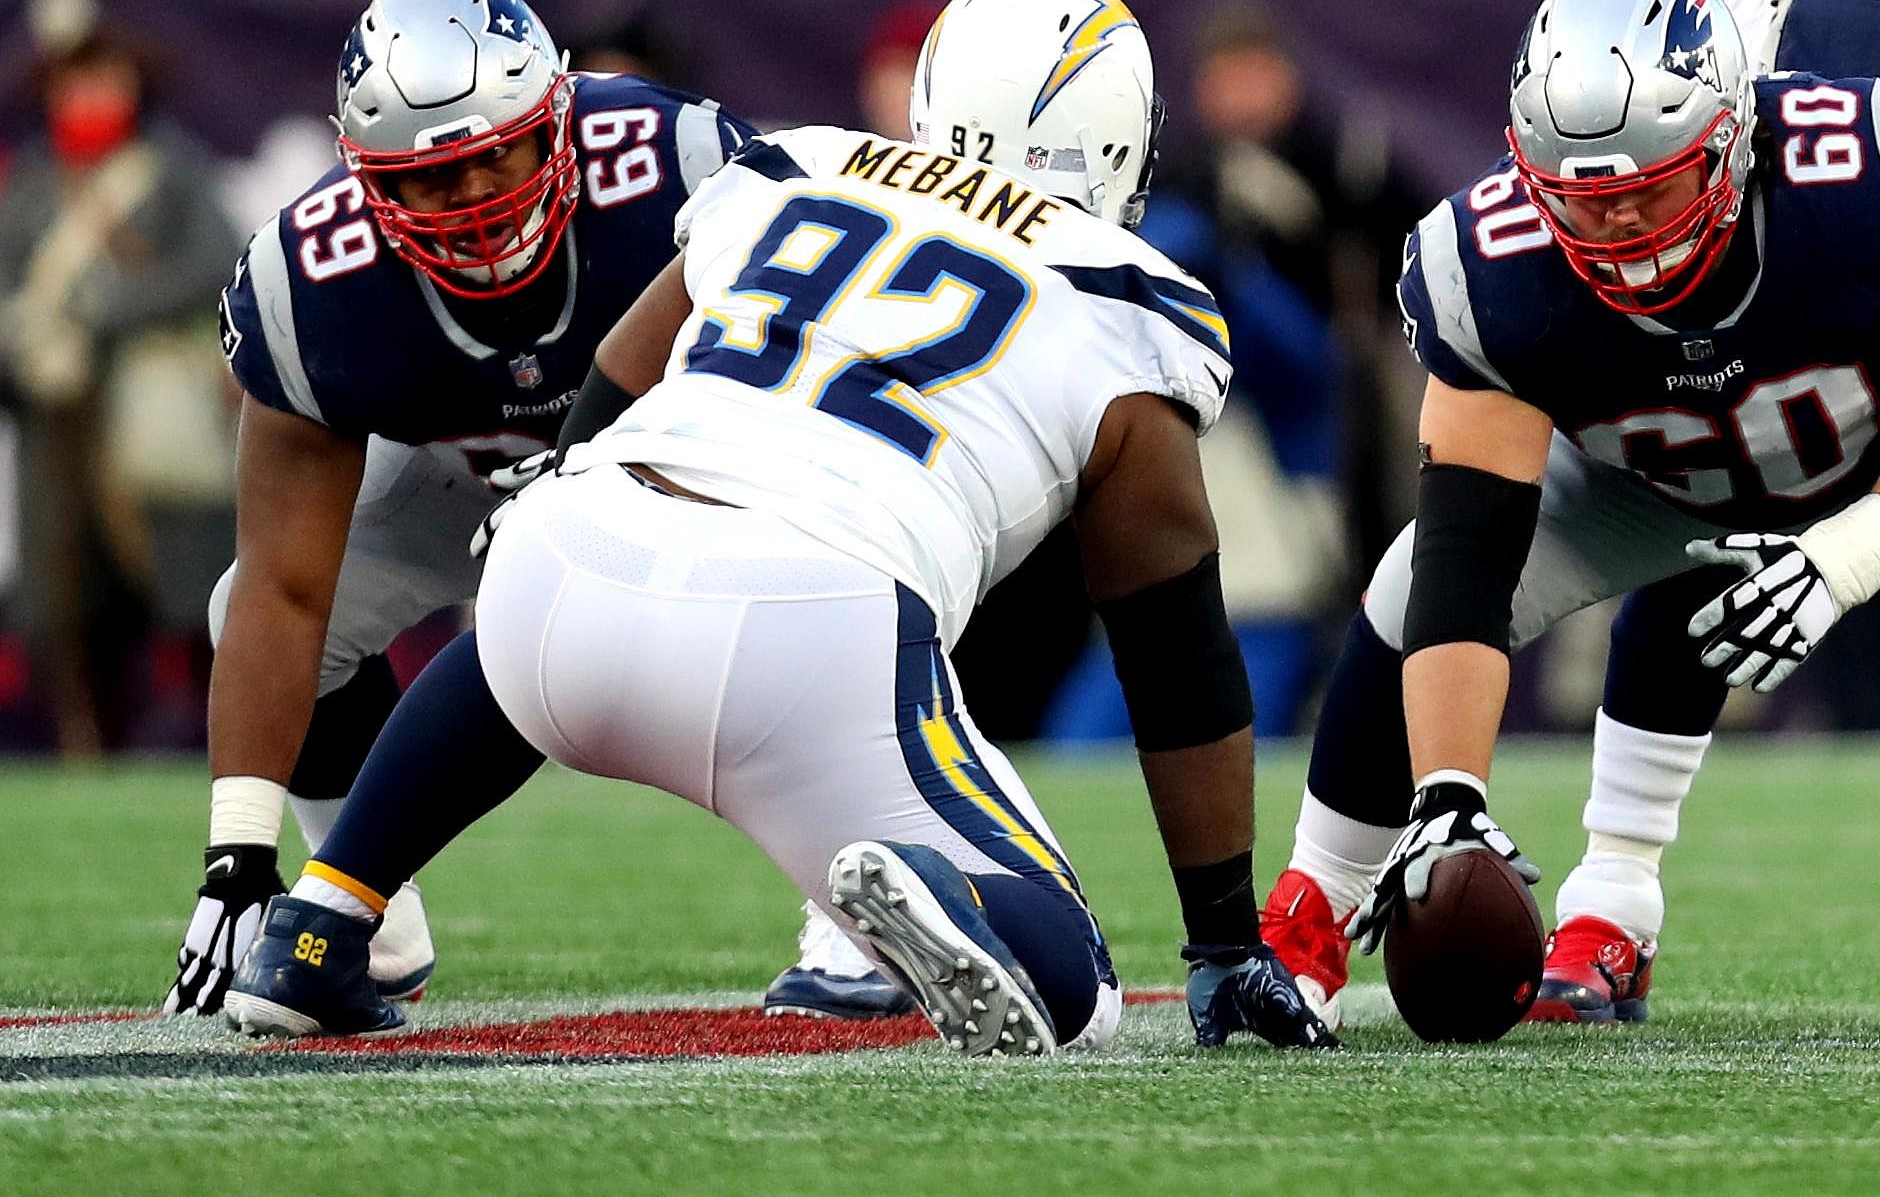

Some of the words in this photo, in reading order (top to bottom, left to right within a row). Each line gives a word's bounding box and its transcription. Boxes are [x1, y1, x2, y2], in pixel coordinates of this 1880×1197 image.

[580, 106, 664, 210] 69
[951, 124, 995, 166] 92
[1779, 83, 1867, 187] 60
[291, 172, 381, 284] 69
[838, 138, 1062, 249] MEBANE
[1467, 164, 1555, 261] 60
[680, 190, 1039, 471] 92
[1666, 359, 1745, 390] PATRIOTS
[294, 931, 328, 967] 92
